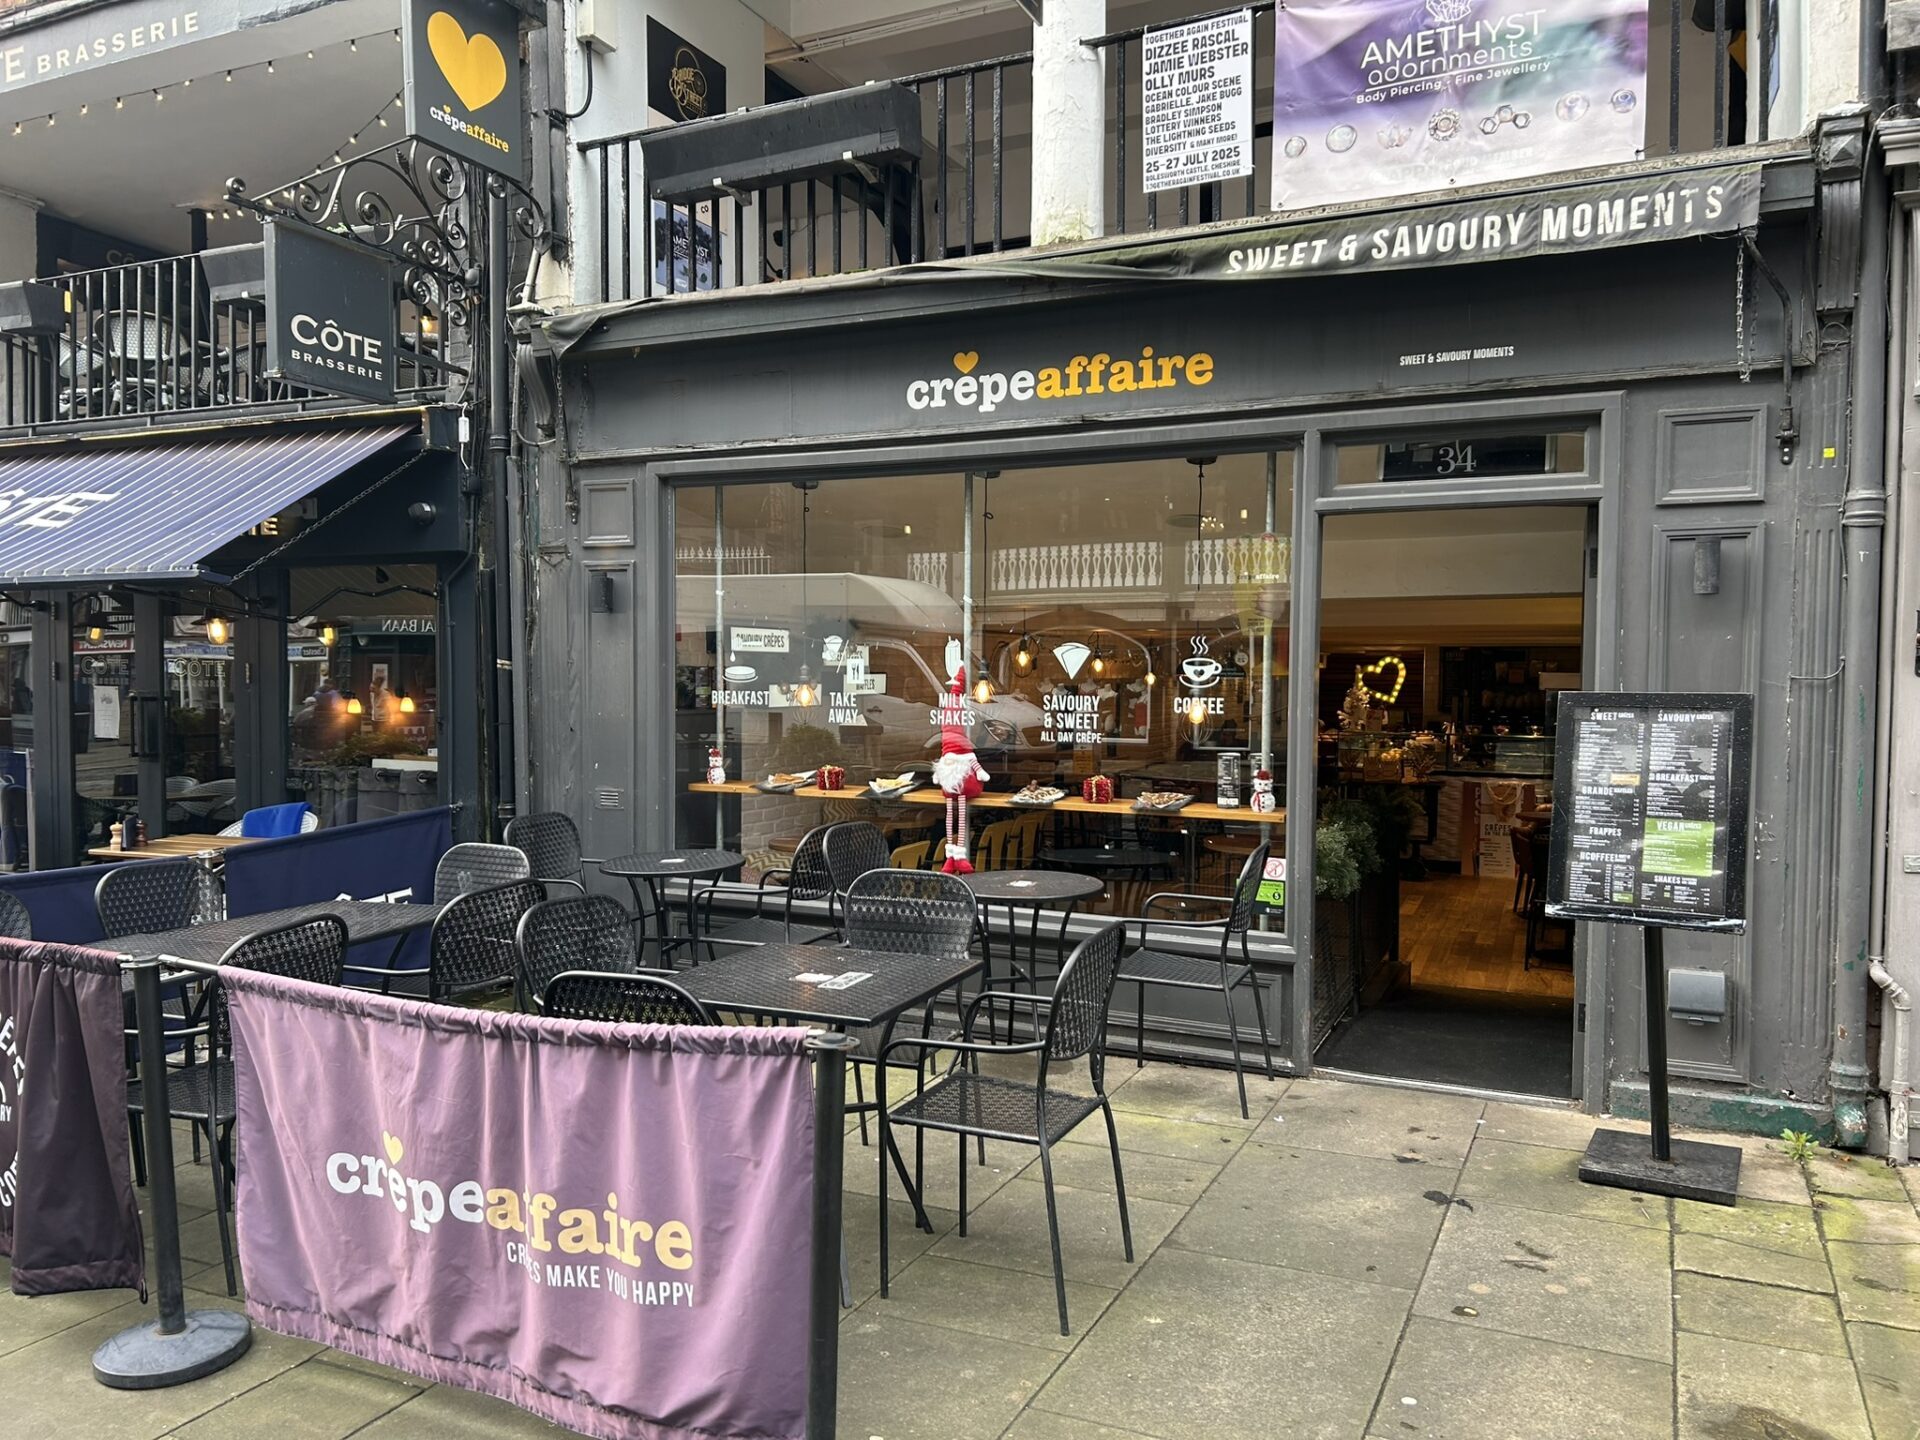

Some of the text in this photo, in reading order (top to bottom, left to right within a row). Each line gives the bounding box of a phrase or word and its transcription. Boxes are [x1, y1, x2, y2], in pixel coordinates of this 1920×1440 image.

[1145, 15, 1248, 45] TOGETHER AGAIN FESTIVAL
[1360, 8, 1546, 70] AMETHYST
[0, 12, 199, 83] E BRASSERIE
[1145, 28, 1239, 61] DIZZEE RASCAL
[1145, 41, 1249, 76] JAMIE WEBSTER
[1368, 39, 1533, 86] adornments
[1145, 65, 1215, 91] OLLY MURS
[1356, 91, 1387, 104] Body
[1390, 79, 1442, 97] Piercing
[1455, 72, 1483, 85] Fine
[1487, 61, 1550, 80] Jewellery
[1145, 75, 1242, 103] OCEAN COLOUR SCENE
[1196, 91, 1217, 104] JAKE
[1220, 86, 1242, 99] BUGG
[1145, 102, 1222, 125] BRADLEY SIMPSON
[1145, 113, 1222, 135] LOTTERY WINNERS
[1145, 120, 1236, 146] THE LIGHTNING SEEDS
[1145, 141, 1187, 157] DIVERSITY
[1196, 137, 1214, 147] MANY
[1216, 133, 1238, 144] MORE!
[1182, 151, 1209, 167] JULY
[1211, 146, 1240, 162] 2025
[1145, 168, 1185, 182] BOLESWORTH
[1211, 159, 1240, 170] CHESHIRE
[1226, 185, 1724, 274] SWEET & SAVOURY MOMENTS
[291, 314, 382, 364] CÔTE
[291, 349, 383, 380] BRASSERIE
[1400, 346, 1515, 366] SWEET & SAVOURY MOMENTS
[1437, 445, 1477, 474] 34
[174, 656, 225, 677] CÔTE
[711, 690, 769, 705] BREAKFAST
[829, 692, 857, 707] TAKE
[938, 693, 967, 708] MILK
[1043, 694, 1101, 711] SAVOURY
[1173, 696, 1224, 714] COFFEE
[828, 708, 859, 724] AWAY
[929, 710, 976, 726] SHAKES
[1043, 713, 1099, 730] & SWEET
[1590, 711, 1617, 720] SWEET
[1657, 713, 1695, 722] SAVOURY
[1040, 731, 1102, 744] ALL DAY CRÊPE
[1655, 773, 1699, 783] BREAKFAST
[1582, 786, 1614, 796] GRANDE
[1589, 826, 1622, 836] FRAPPES
[1656, 820, 1684, 832] VEGAN
[1654, 875, 1681, 884] SHAKES
[546, 1264, 601, 1288] MAKE
[606, 1267, 628, 1300] YOU
[632, 1279, 694, 1307] HAPPY
